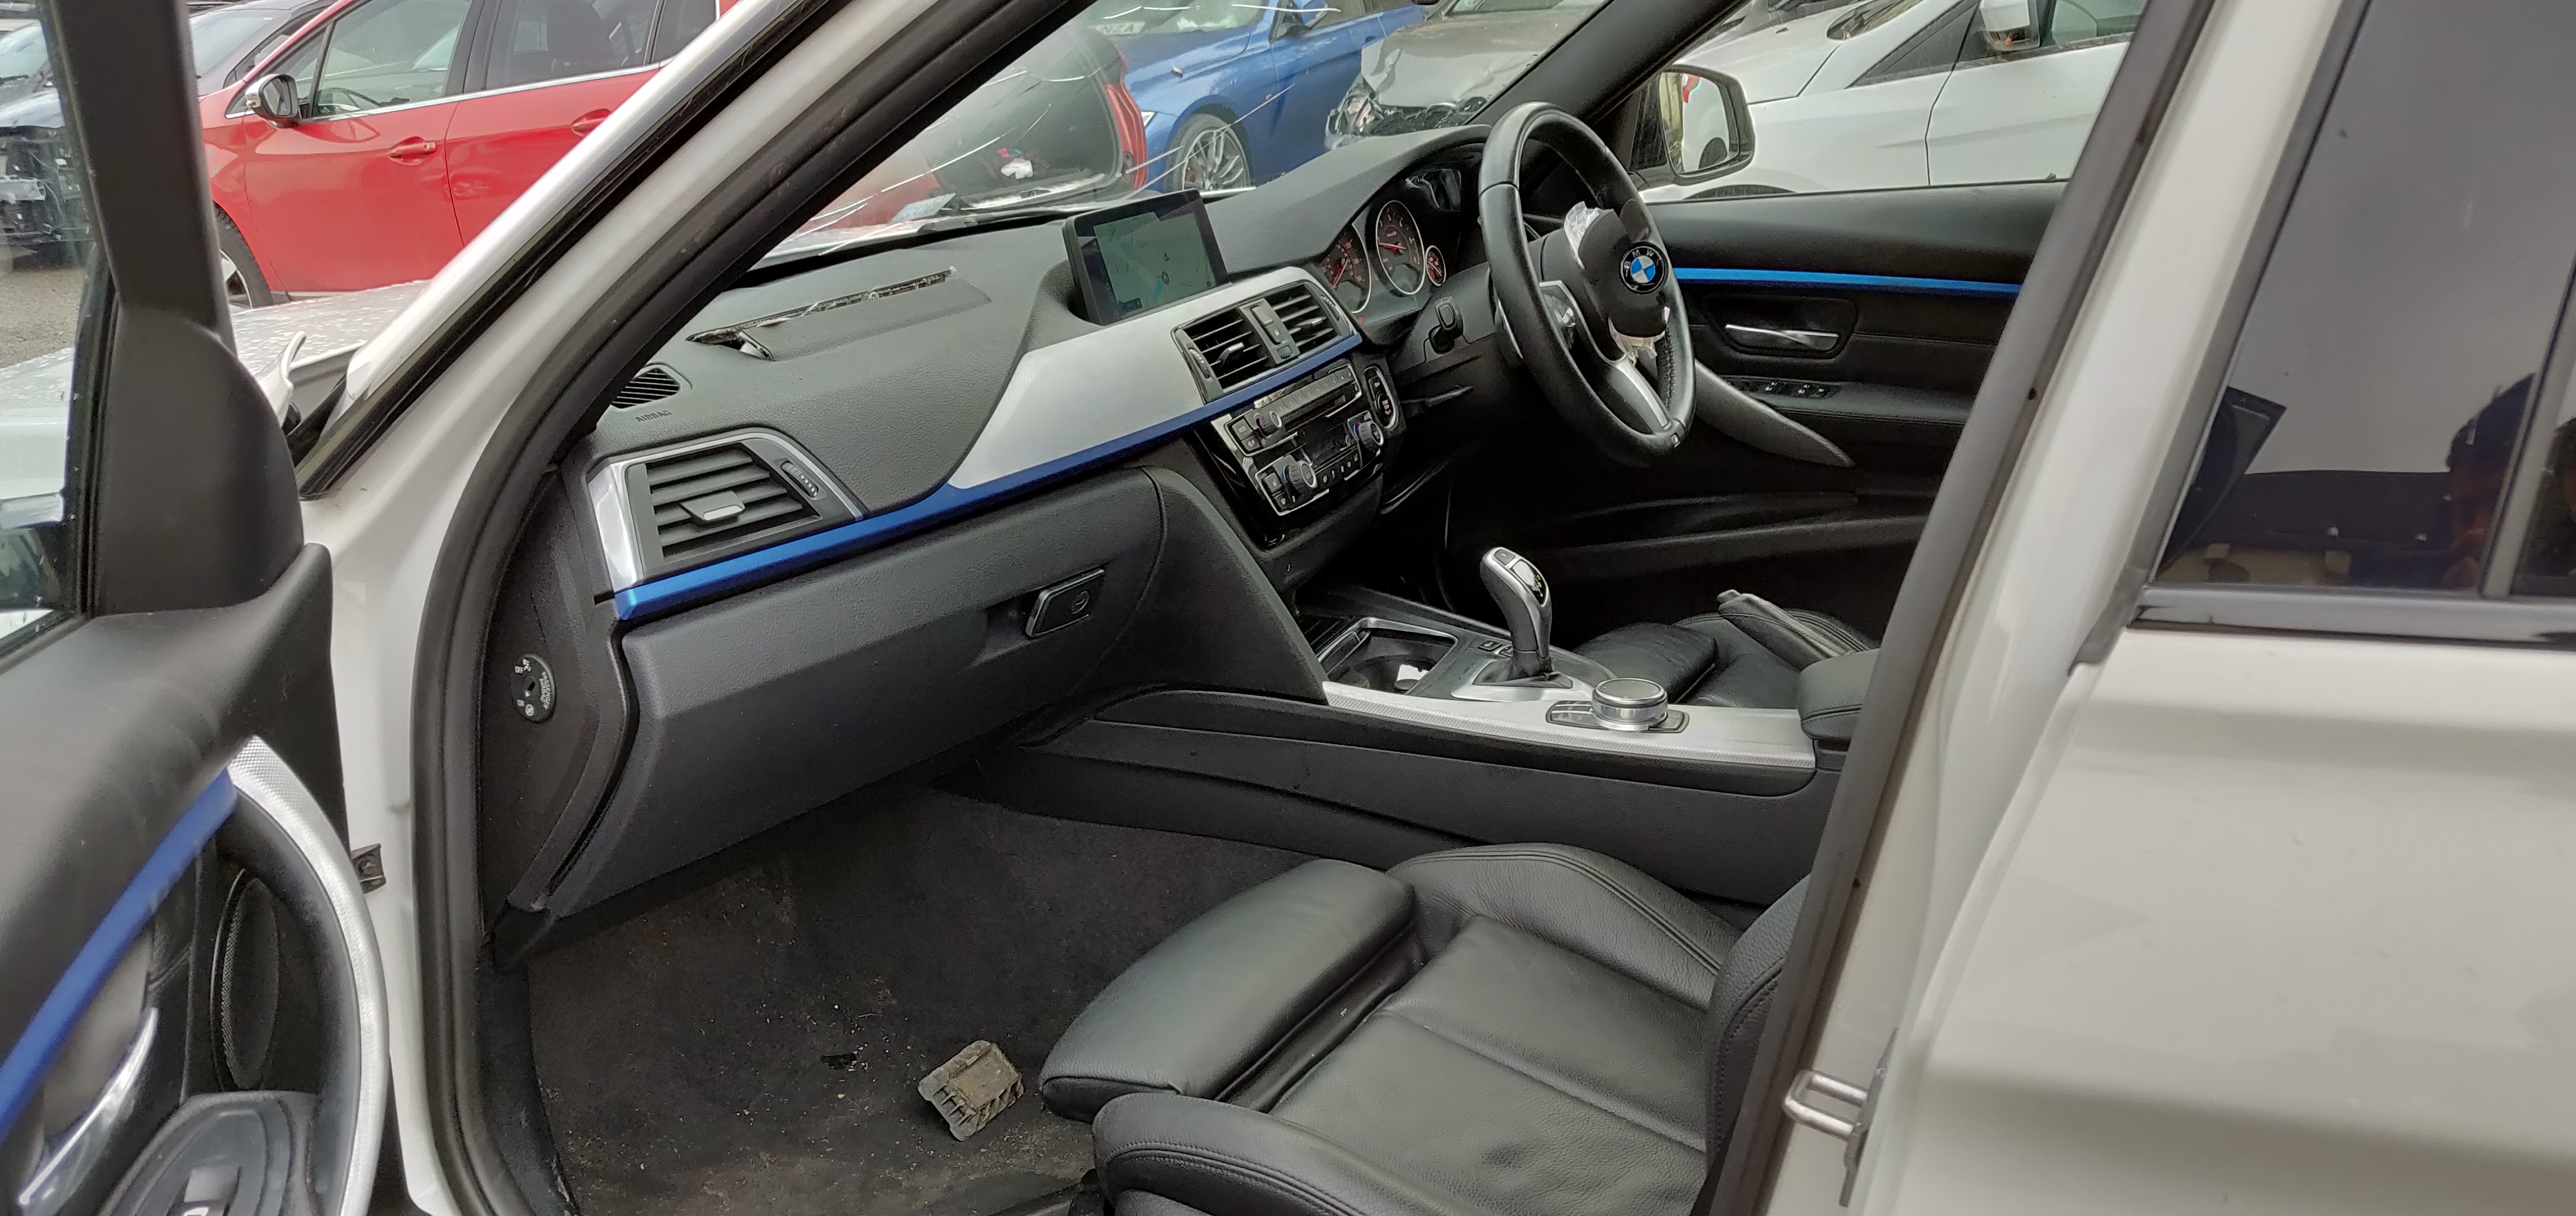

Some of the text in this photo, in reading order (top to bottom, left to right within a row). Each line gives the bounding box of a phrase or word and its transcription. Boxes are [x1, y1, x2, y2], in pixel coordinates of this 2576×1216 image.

[1623, 249, 1654, 269] BMW
[635, 410, 673, 422] AIRBAG
[541, 671, 551, 710] PASSENGER
